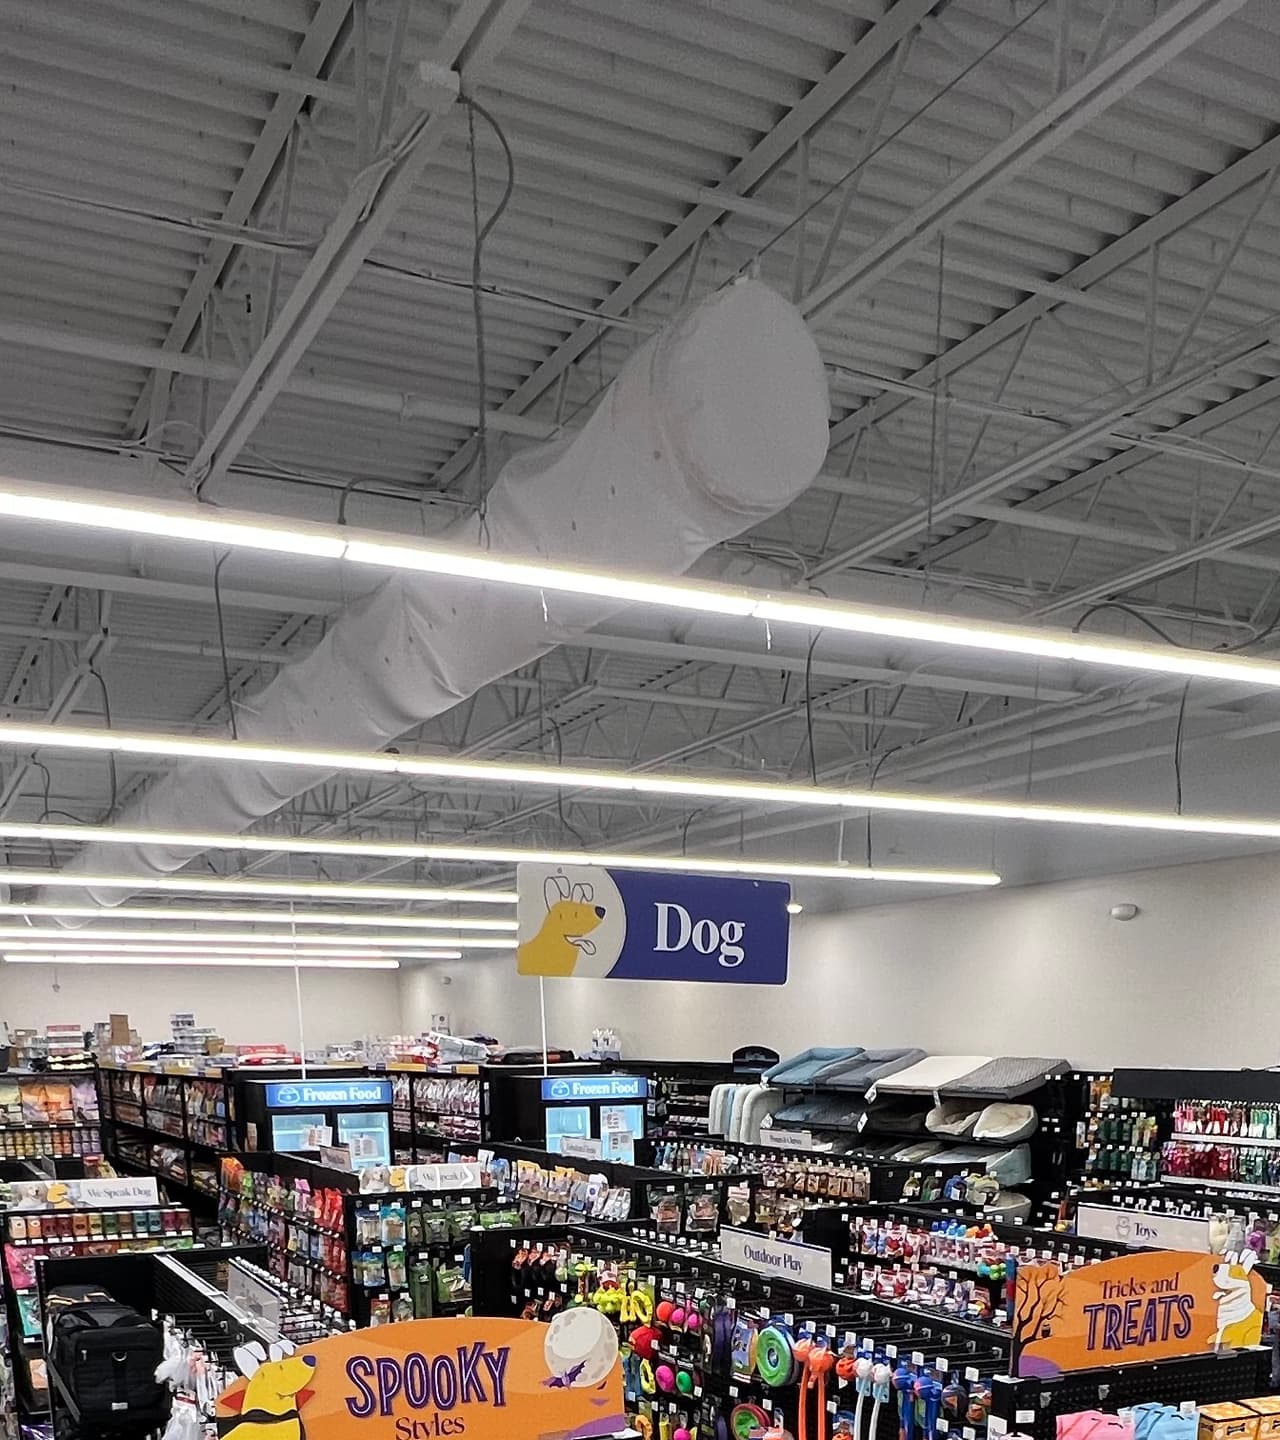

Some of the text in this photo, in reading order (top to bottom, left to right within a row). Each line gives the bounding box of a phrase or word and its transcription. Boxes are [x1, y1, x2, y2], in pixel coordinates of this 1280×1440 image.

[653, 902, 746, 967] Dog
[303, 1085, 382, 1101] Frozen Food
[573, 1077, 639, 1095] Frozen Food
[1134, 1222, 1158, 1238] Toys
[744, 1245, 803, 1275] Outdoor Play
[1100, 1272, 1179, 1299] Tricks and
[1083, 1294, 1195, 1351] TREATS
[344, 1341, 511, 1419] SPOOKY
